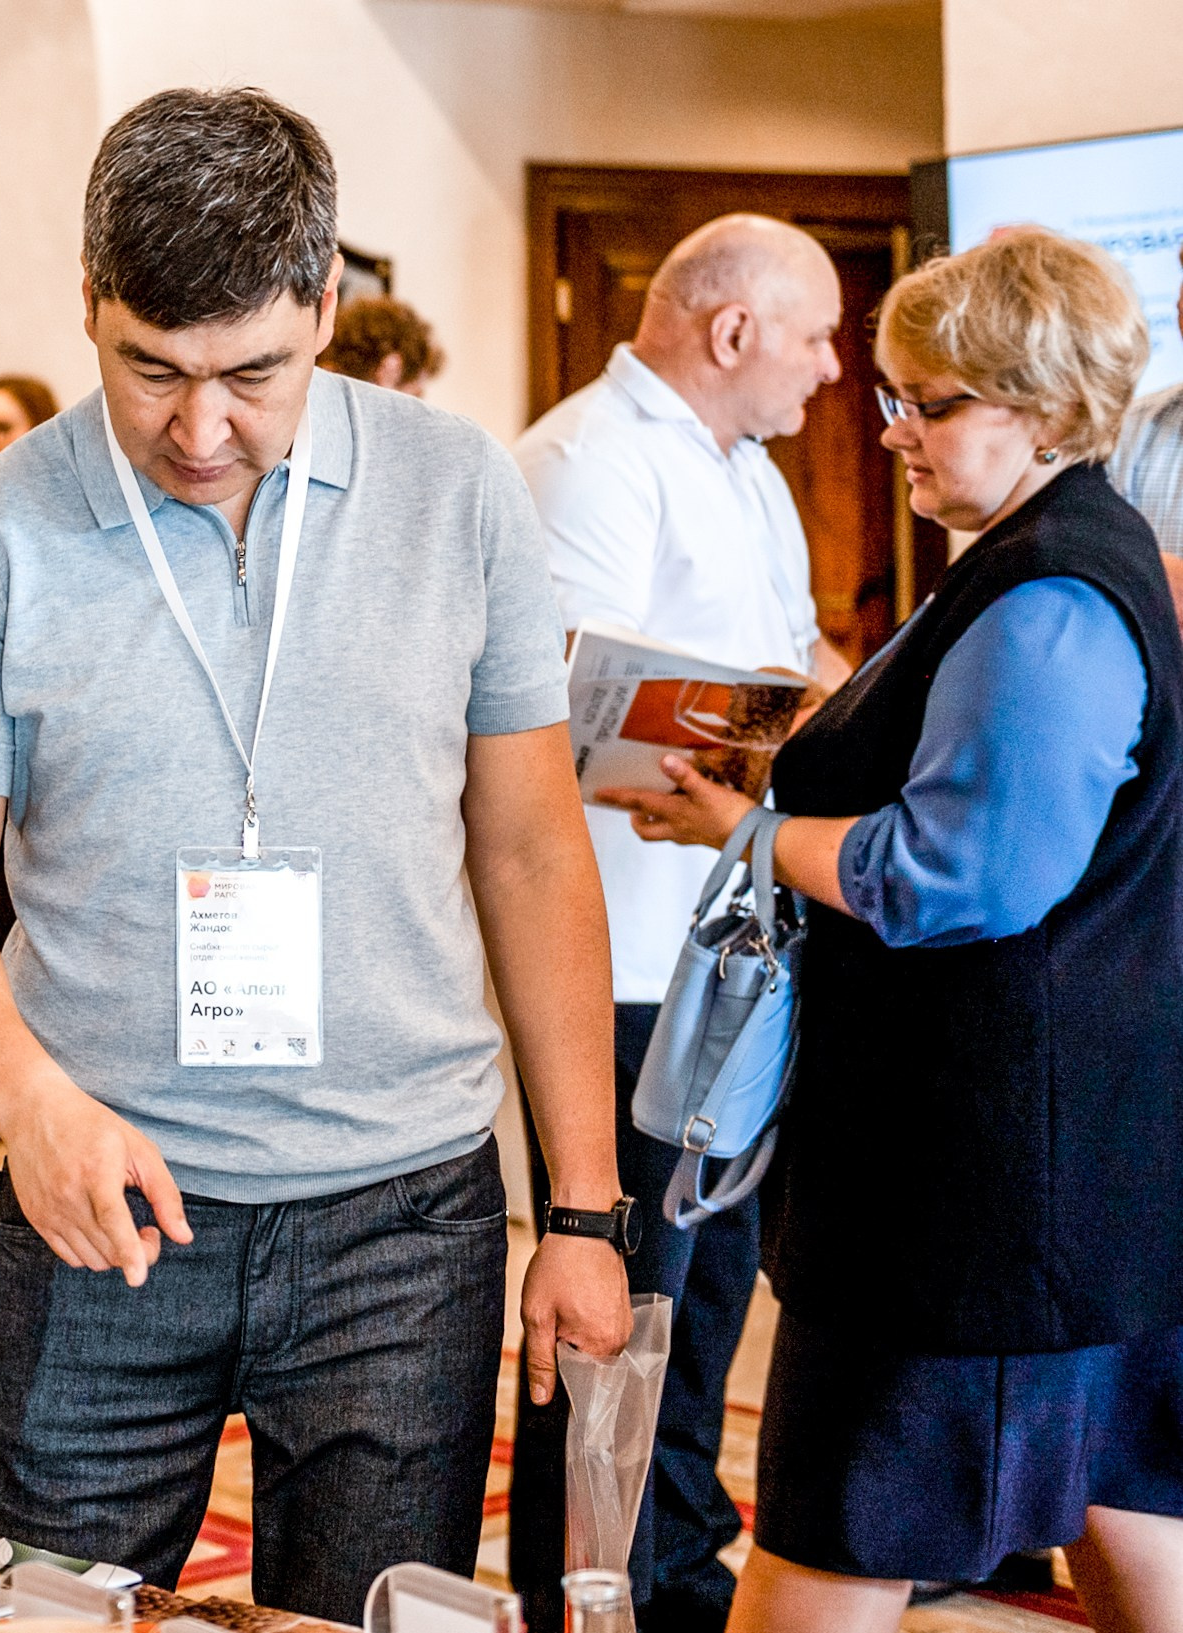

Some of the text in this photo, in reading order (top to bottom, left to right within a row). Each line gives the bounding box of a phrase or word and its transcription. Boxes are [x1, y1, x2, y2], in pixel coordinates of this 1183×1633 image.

[190, 910, 238, 920] Ахметов
[190, 922, 233, 933] Жандос
[190, 981, 217, 995] АО
[190, 1002, 244, 1020] Агро»
